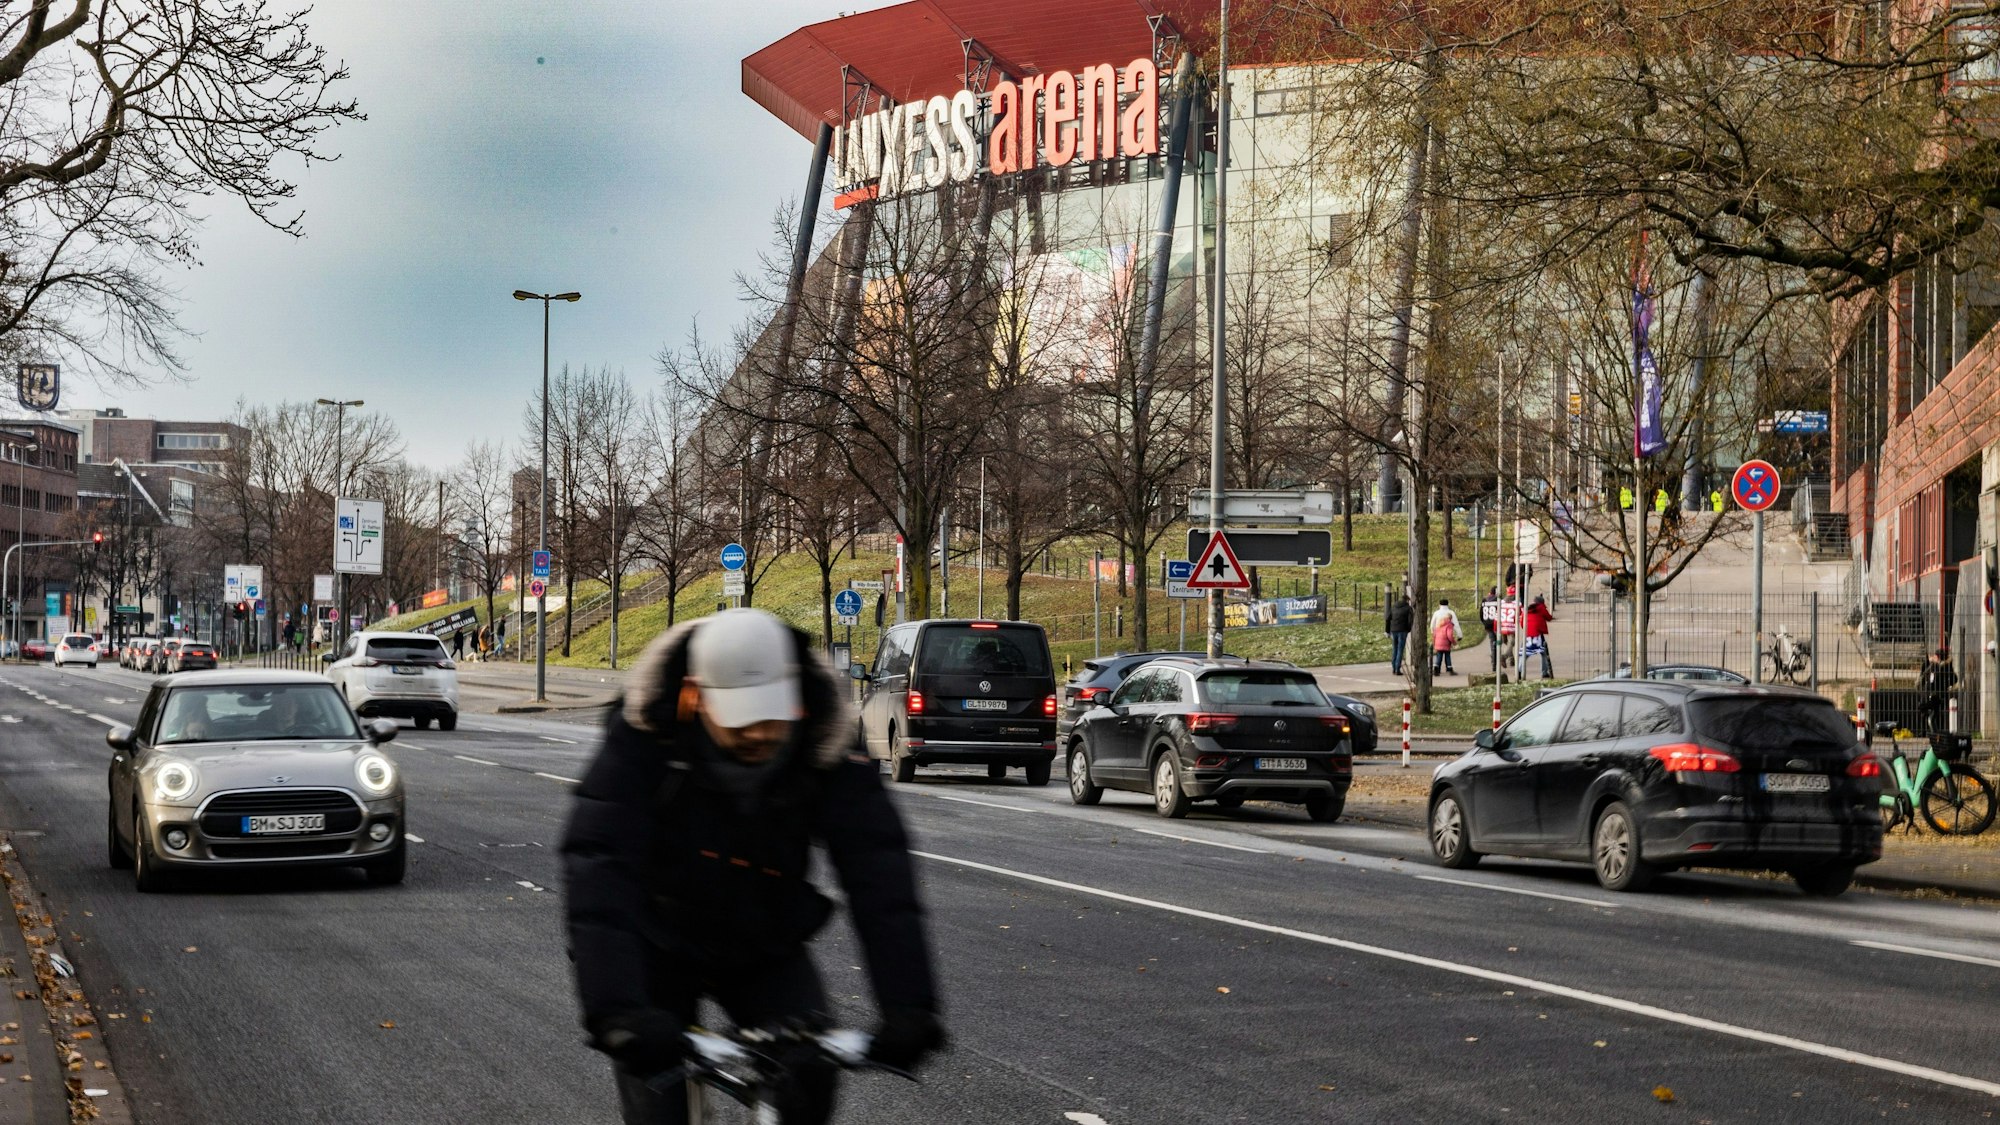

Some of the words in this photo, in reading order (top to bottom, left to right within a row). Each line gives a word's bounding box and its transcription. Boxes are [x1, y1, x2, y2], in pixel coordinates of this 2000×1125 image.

[834, 89, 977, 197] LANXESS
[989, 58, 1159, 176] arena
[1172, 585, 1195, 593] Zentrum
[1285, 600, 1318, 610] 31.12.2022
[1501, 608, 1515, 622] 52
[452, 616, 476, 629] WILLIAMS
[988, 701, 1005, 709] 9876
[1284, 760, 1305, 768] 3636
[250, 819, 268, 831] BM
[277, 818, 295, 830] SJ
